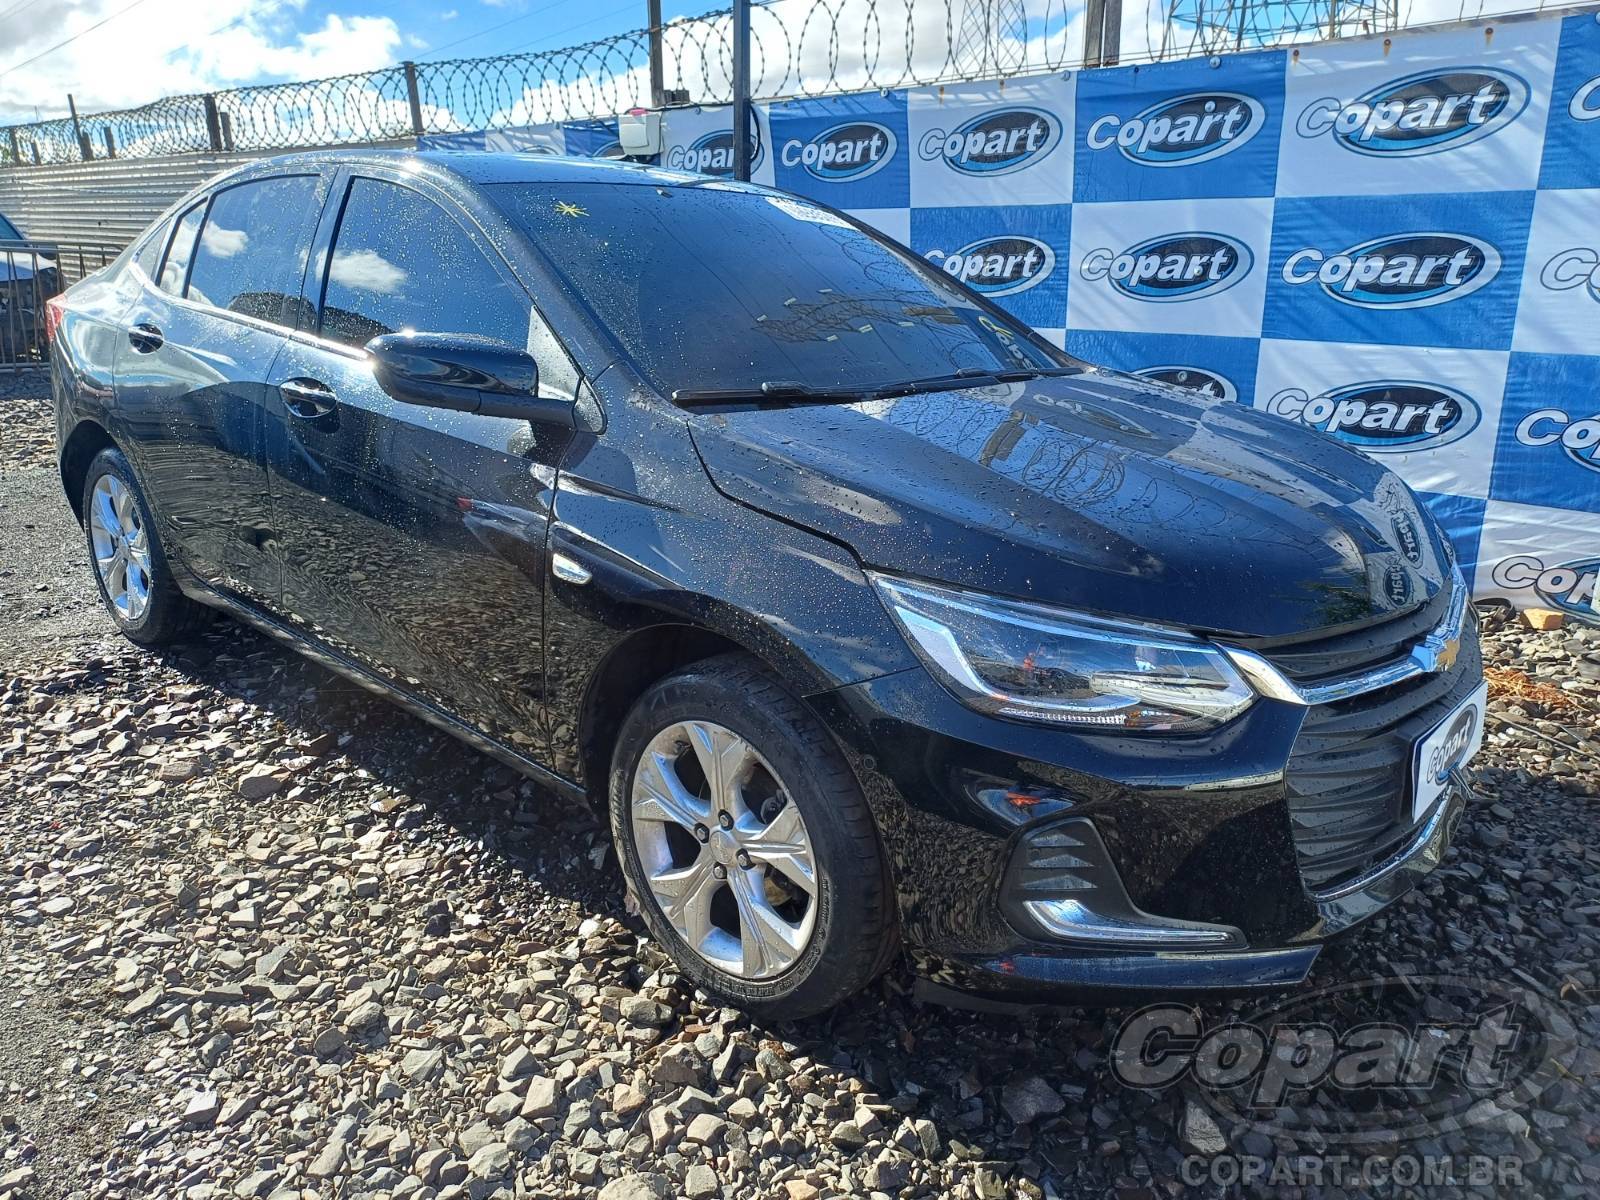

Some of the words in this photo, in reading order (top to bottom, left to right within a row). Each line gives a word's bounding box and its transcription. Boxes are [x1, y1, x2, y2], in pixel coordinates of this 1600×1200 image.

[1086, 99, 1249, 155] Copart
[1295, 79, 1502, 142] Copart
[667, 144, 734, 173] Copar
[781, 132, 882, 171] Copart
[918, 118, 1046, 165] Copart
[1079, 243, 1231, 287] Copart
[1281, 245, 1476, 293] Copart
[1266, 386, 1455, 436] Copart
[1426, 714, 1473, 784] Copart
